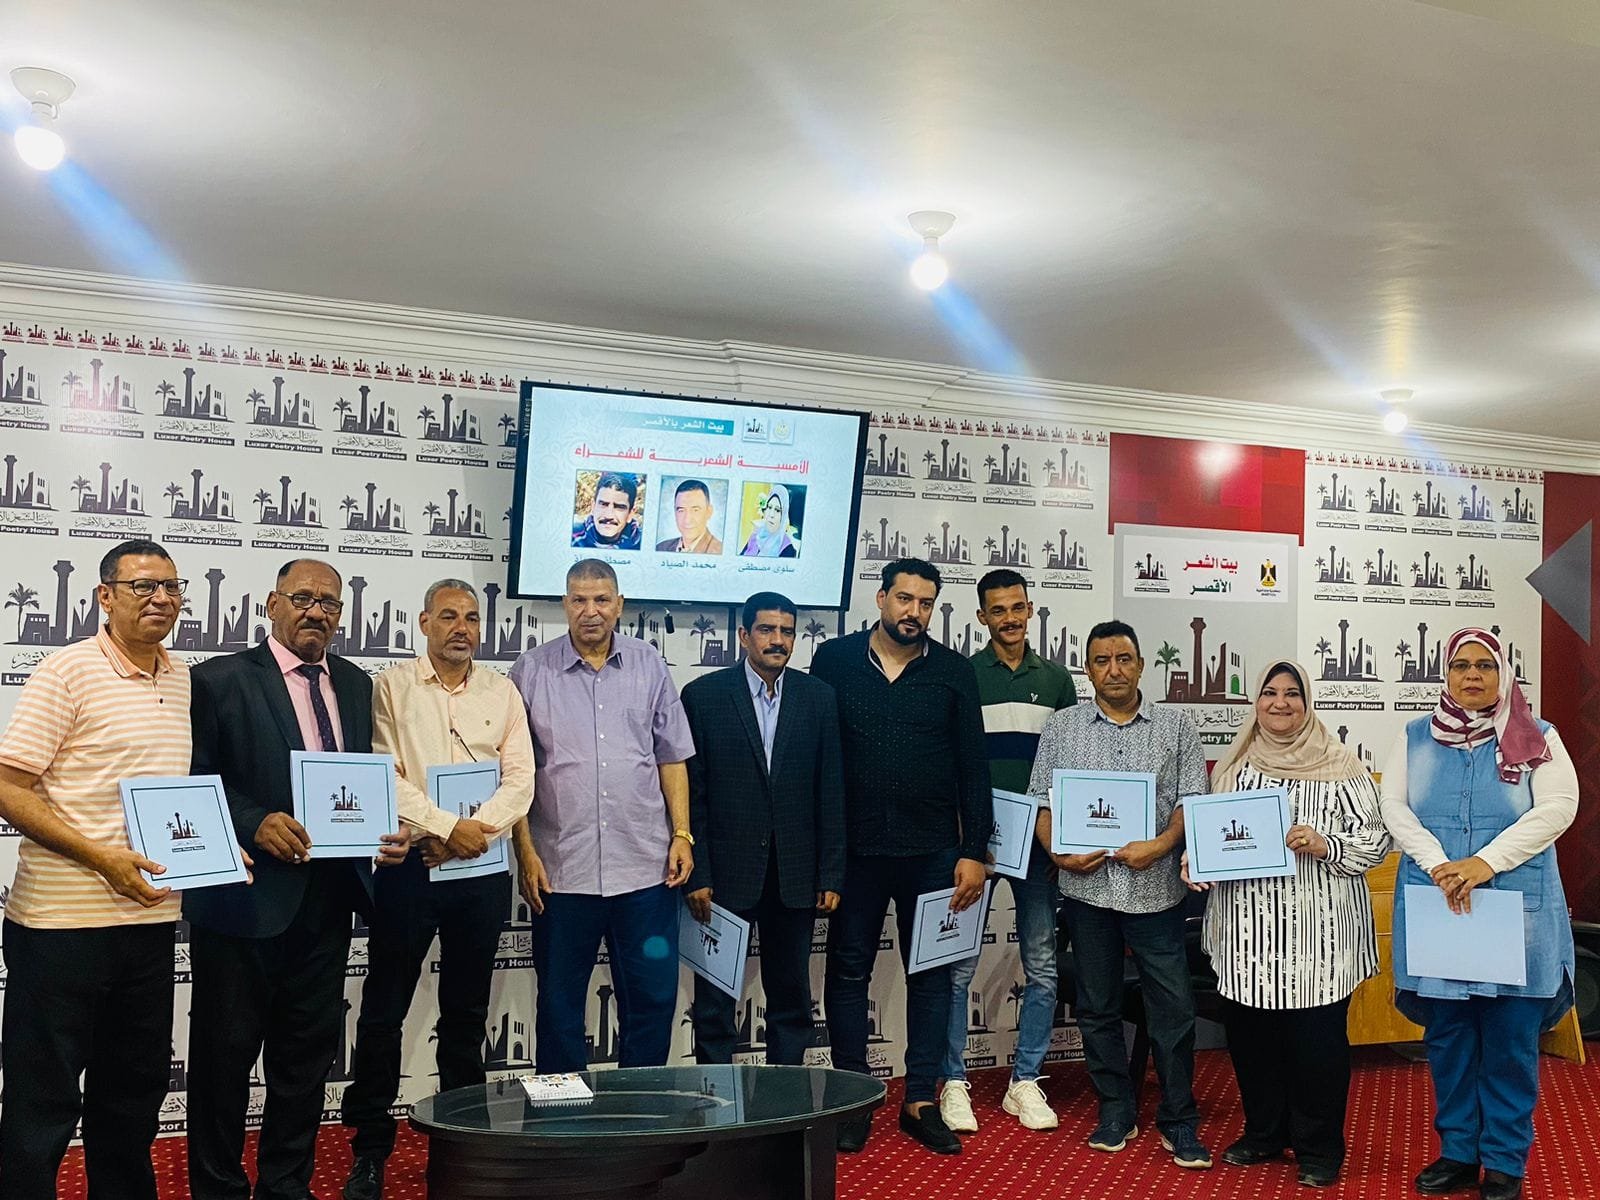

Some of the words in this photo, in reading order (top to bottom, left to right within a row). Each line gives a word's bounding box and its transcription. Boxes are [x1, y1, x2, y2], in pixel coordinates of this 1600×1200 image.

[20, 422, 48, 430] House
[682, 418, 705, 429] الشعر
[708, 420, 724, 434] بيت
[180, 435, 206, 443] Poetry
[207, 437, 232, 445] House
[270, 442, 295, 450] Poetry
[356, 450, 381, 458] Poetry
[1, 525, 29, 534] Poetry
[30, 527, 57, 535] House
[96, 531, 123, 539] Poetry
[692, 562, 717, 570] محمد
[1183, 554, 1219, 571] الشعر
[1220, 558, 1238, 574] بيت
[1337, 702, 1360, 710] Poetry
[1201, 733, 1222, 744] etry
[1063, 1050, 1084, 1059] Hous
[966, 1059, 993, 1068] House
[159, 1122, 181, 1131] xor
